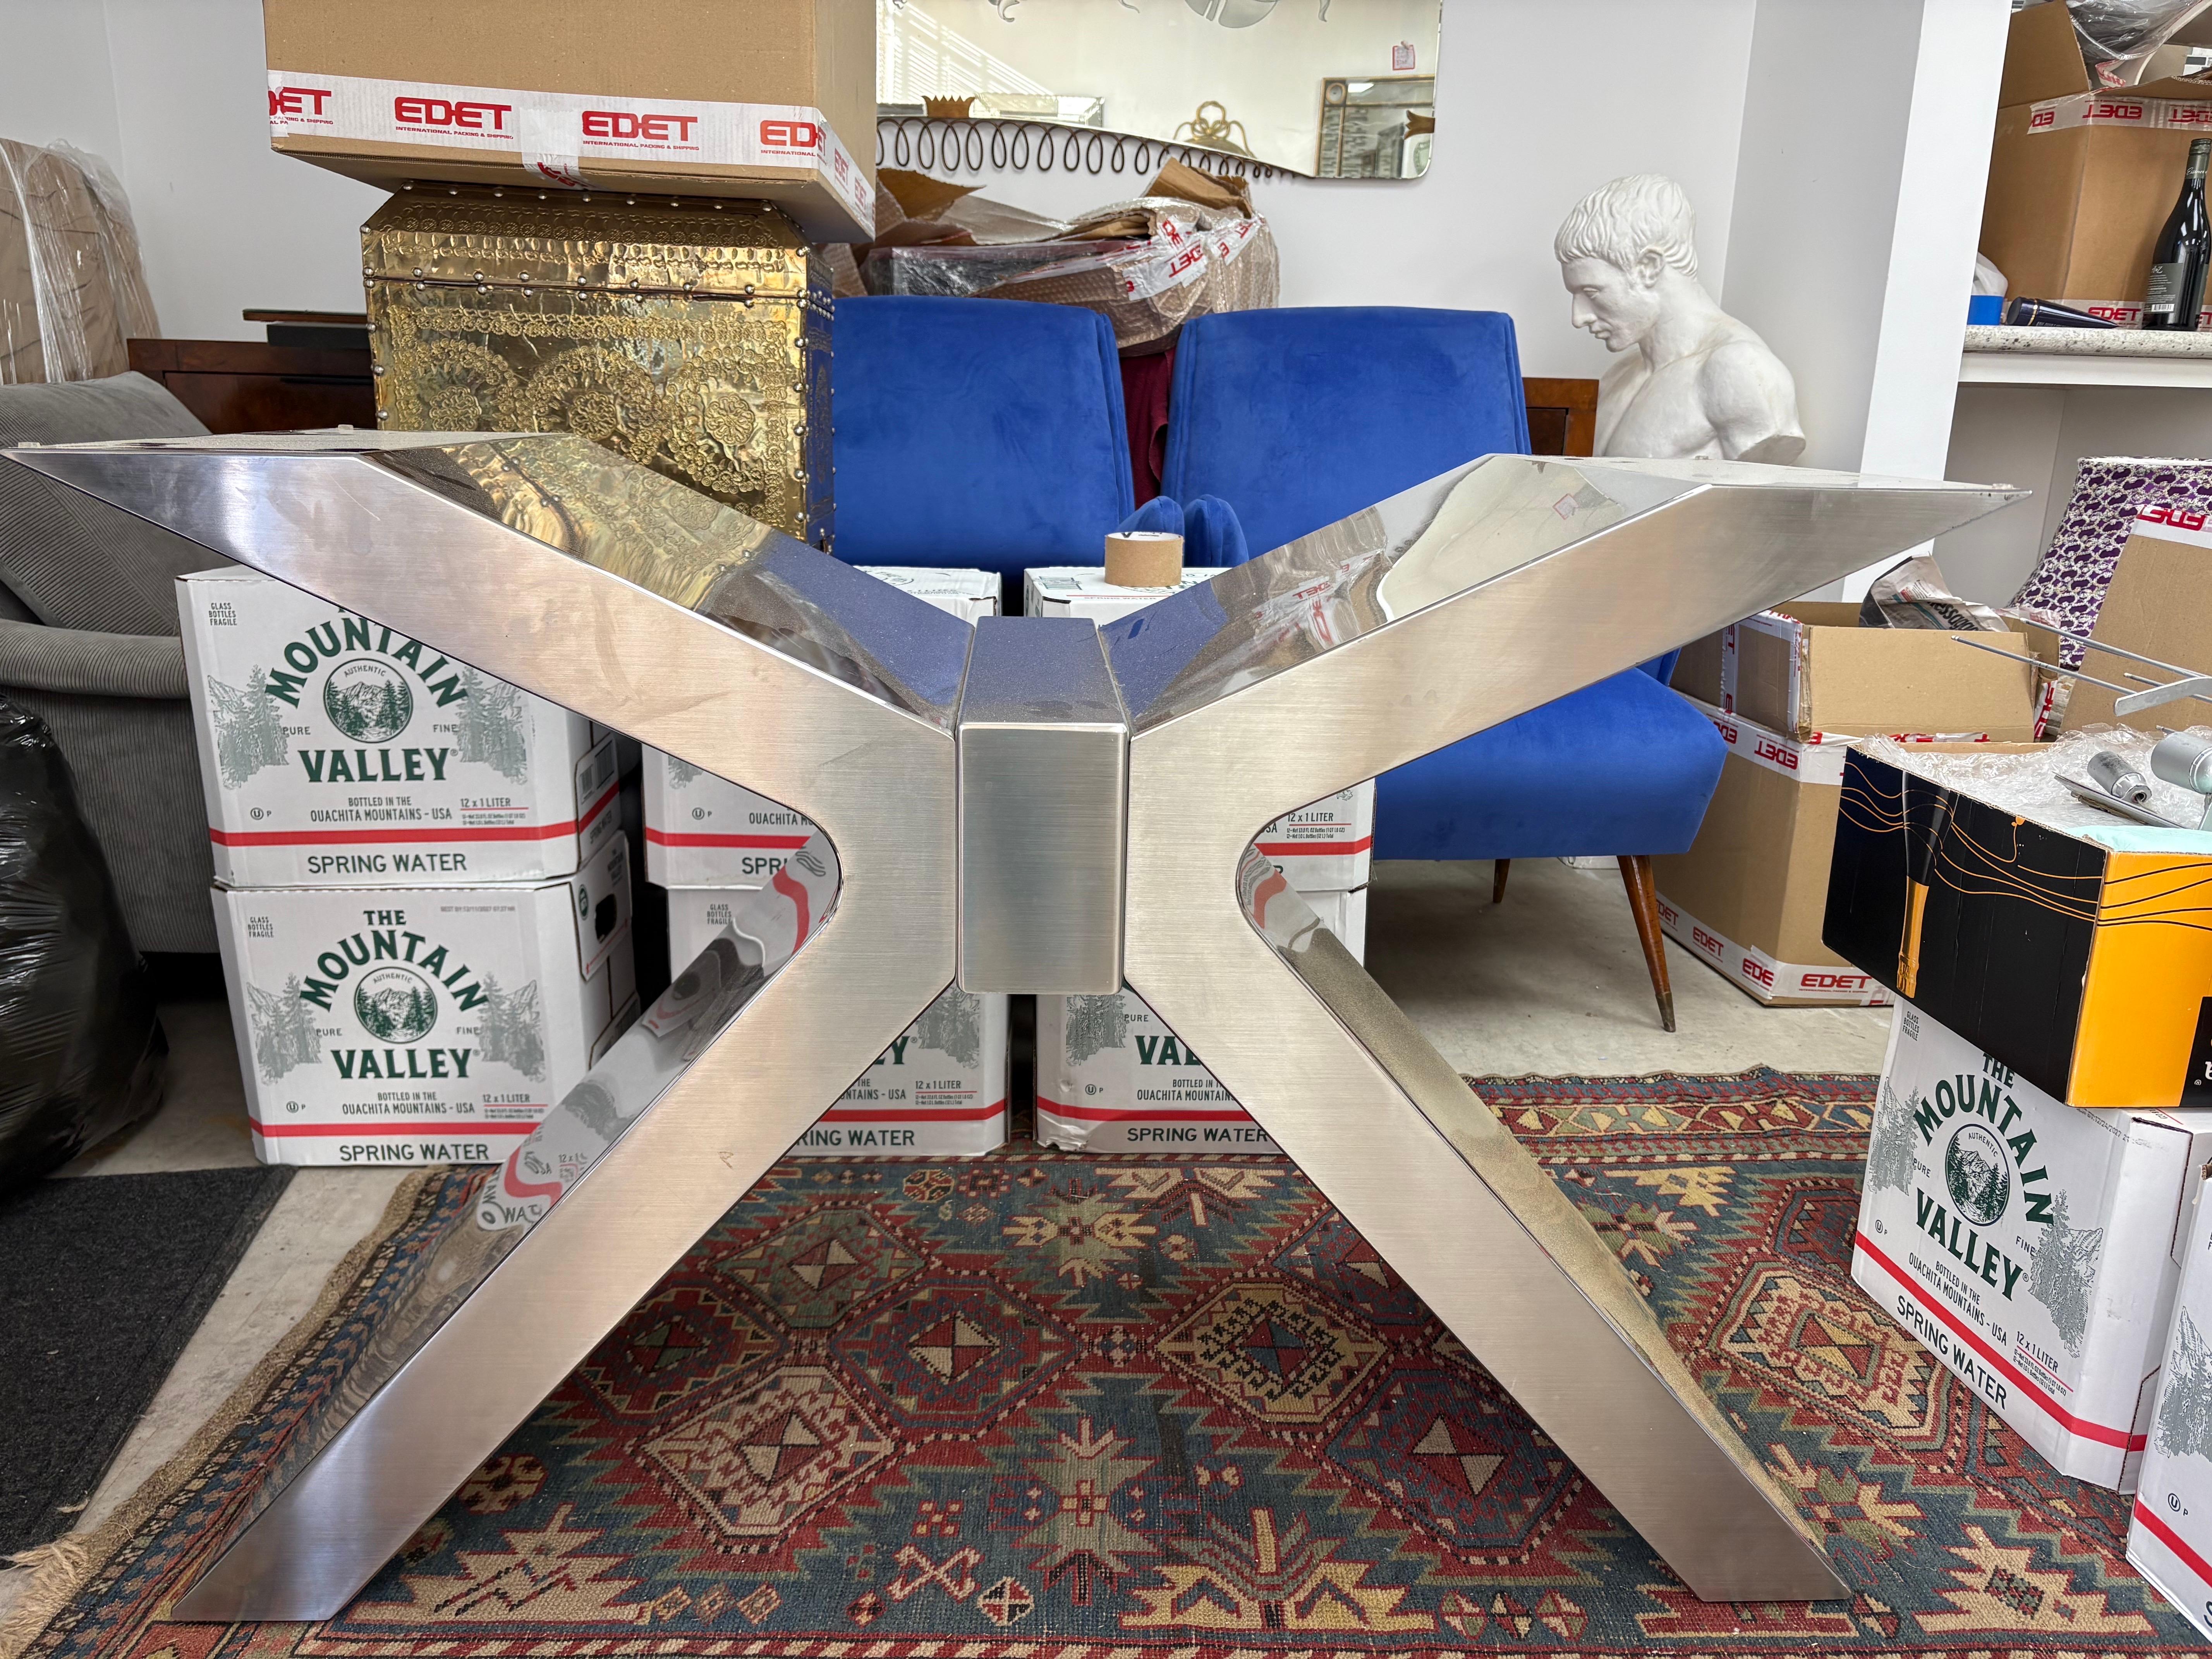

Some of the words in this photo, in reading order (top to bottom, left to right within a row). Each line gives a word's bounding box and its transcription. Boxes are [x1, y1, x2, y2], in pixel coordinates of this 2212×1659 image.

[395, 96, 512, 130] EDET
[2082, 105, 2142, 120] EDET
[395, 126, 452, 135] INTERNATIONAL
[582, 111, 698, 141] EDET
[343, 665, 386, 677] AUTHENTIC
[283, 726, 311, 735] PURE
[433, 724, 458, 733] FINE
[1754, 741, 1798, 770] EDET
[298, 748, 450, 783] VALLEY
[349, 797, 383, 807] BOTTLED
[386, 797, 393, 806] IN
[396, 796, 412, 806] THE
[460, 798, 470, 807] 12
[480, 798, 484, 807] 1
[486, 797, 511, 807] LITER
[310, 809, 362, 822] OUACHITA
[365, 808, 422, 821] MOUNTAINS
[431, 807, 453, 820] USA
[749, 812, 798, 826] OUACHITA
[1288, 813, 1296, 822] 12
[1306, 812, 1309, 822] 1
[1311, 812, 1333, 822] LITER
[1261, 823, 1278, 833] SA
[308, 855, 386, 873] SPRING
[393, 854, 467, 871] WATER
[363, 910, 406, 926] THE
[1693, 926, 1723, 957] EDET
[299, 929, 489, 1012] MOUNTAIN
[373, 973, 413, 984] AUTHENTIC
[1801, 974, 1872, 988] EDET
[1124, 1014, 1149, 1022] PURE
[1903, 1017, 1920, 1033] BOTTLES
[1907, 1011, 1919, 1024] GLASS
[316, 1027, 343, 1037] PURE
[457, 1026, 481, 1035] FINE
[1902, 1025, 1918, 1041] FRAGILE
[331, 1048, 472, 1079] VALLEY
[1983, 1052, 2015, 1089] THE
[915, 1080, 924, 1089] 12
[933, 1080, 936, 1089] 1
[939, 1080, 961, 1089] LITER
[1173, 1079, 1203, 1088] BOTTLED
[1206, 1079, 1213, 1088] IN
[377, 1092, 410, 1101] BOTTLED
[412, 1092, 421, 1101] IN
[423, 1092, 437, 1101] THE
[483, 1094, 491, 1103] 12
[500, 1094, 504, 1103] 1
[507, 1094, 531, 1103] LITER
[888, 1089, 906, 1099] USA
[1137, 1089, 1182, 1101] OUACHITA
[342, 1103, 389, 1115] OUACHITA
[393, 1103, 447, 1114] MOUNTAINS
[456, 1102, 475, 1113] USA
[848, 1130, 915, 1146] WATER
[1127, 1128, 1197, 1142] SPRING
[1204, 1128, 1269, 1142] WATER
[339, 1144, 414, 1161] SPRING
[420, 1144, 489, 1161] WATER
[1913, 1074, 2054, 1226] MOUNTAIN
[1968, 1132, 1999, 1158] AUTHENTIC
[1913, 1158, 1931, 1178] PURE
[1917, 1187, 2023, 1302] VALLEY
[2016, 1235, 2037, 1257] FINE
[1936, 1261, 1960, 1288] BOTTLED
[1961, 1281, 1968, 1295] IN
[1970, 1288, 1980, 1305] THE
[1909, 1252, 1941, 1291] OUACHITA
[1943, 1281, 1985, 1326] MOUNTAINS
[1992, 1322, 2007, 1346] USA
[1897, 1295, 1948, 1355] SPRING
[1953, 1343, 2007, 1410] WATER
[2017, 1331, 2024, 1346] 12
[2025, 1341, 2030, 1351] x
[2032, 1344, 2035, 1355] 1
[2037, 1348, 2058, 1374] LITER
